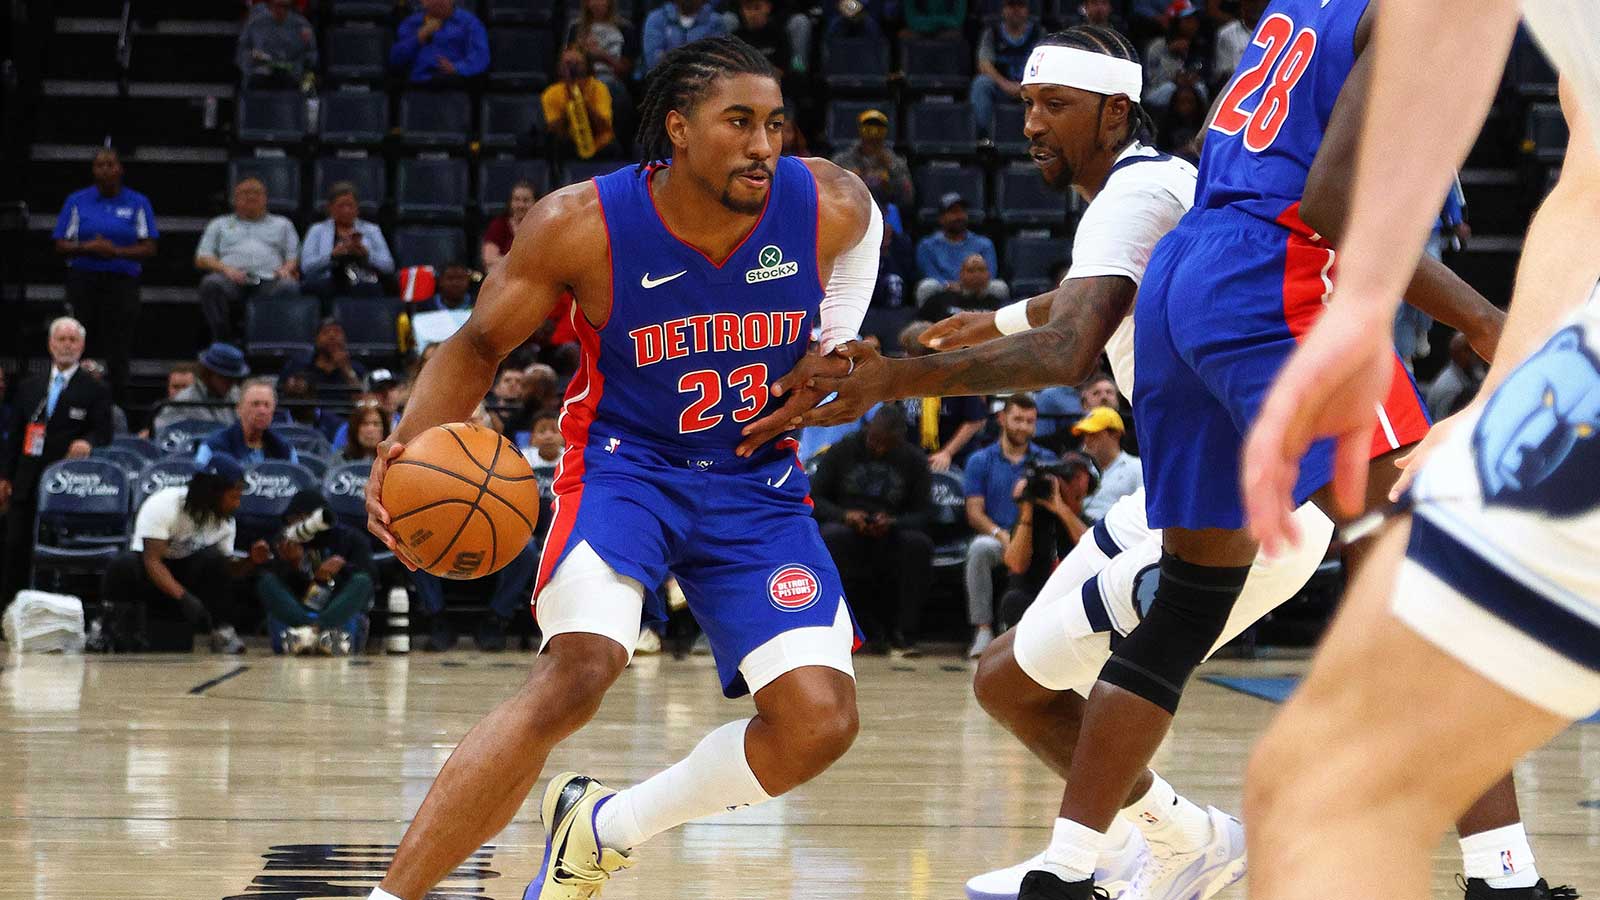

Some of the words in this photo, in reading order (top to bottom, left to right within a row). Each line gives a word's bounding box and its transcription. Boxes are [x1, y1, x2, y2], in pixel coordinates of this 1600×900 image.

[1209, 12, 1318, 153] 28
[747, 263, 797, 282] StockX
[629, 310, 807, 368] DETROIT
[678, 362, 770, 435] 23
[777, 578, 810, 591] DETROIT
[778, 586, 811, 598] PISTONS
